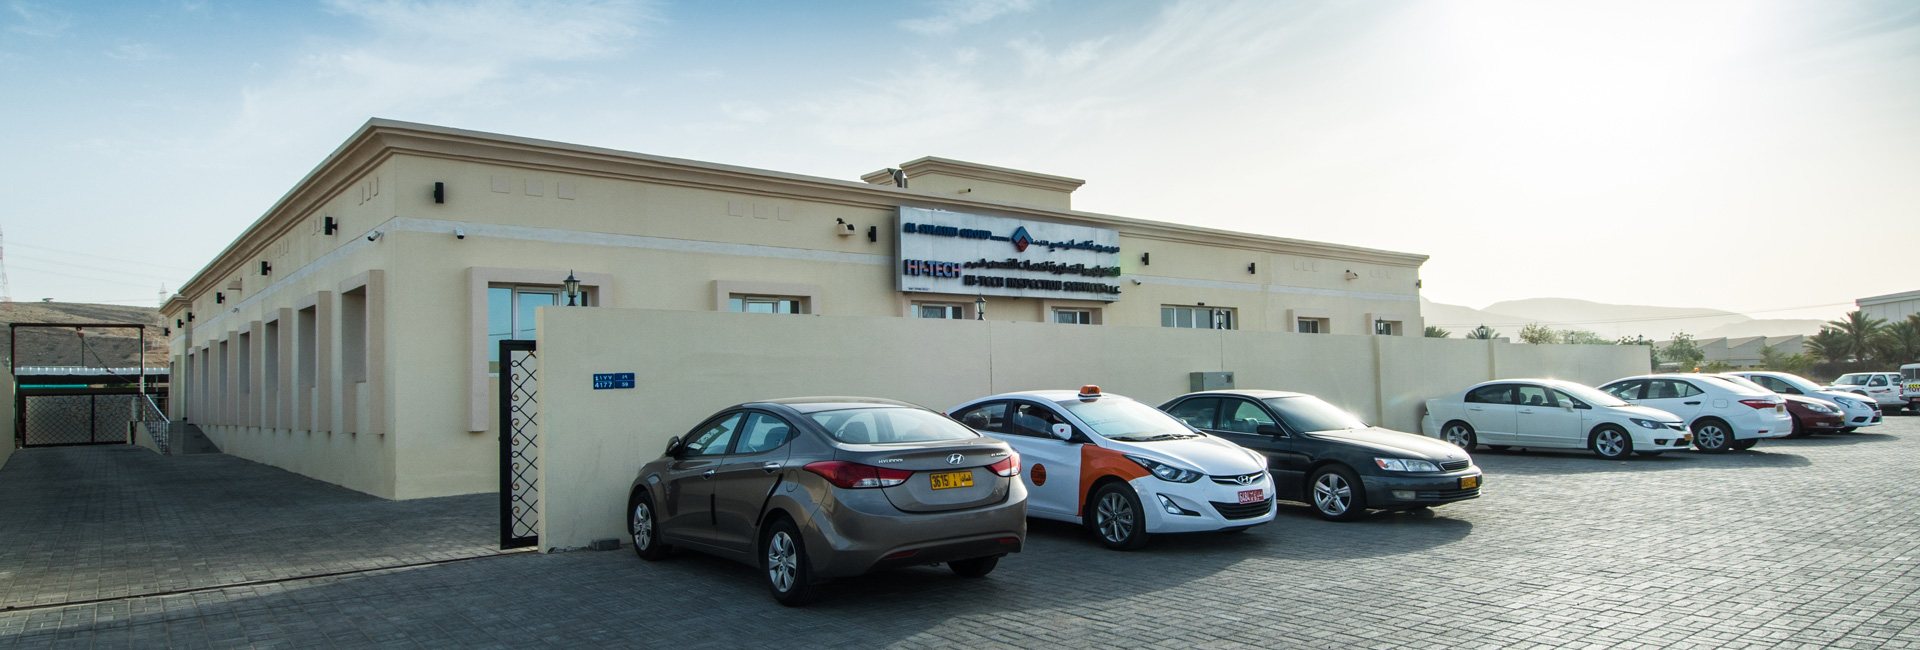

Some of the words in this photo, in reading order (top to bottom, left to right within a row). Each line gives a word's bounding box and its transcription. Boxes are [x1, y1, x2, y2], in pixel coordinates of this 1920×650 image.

[904, 223, 917, 233] AL
[918, 224, 957, 237] SULAIMI
[959, 228, 992, 240] GROUP
[904, 259, 962, 278] HI-TECH
[963, 275, 1004, 288] HI-TECH
[1005, 277, 1062, 291] INSPECTION
[1062, 281, 1105, 293] SERVICES
[932, 474, 949, 488] 3615
